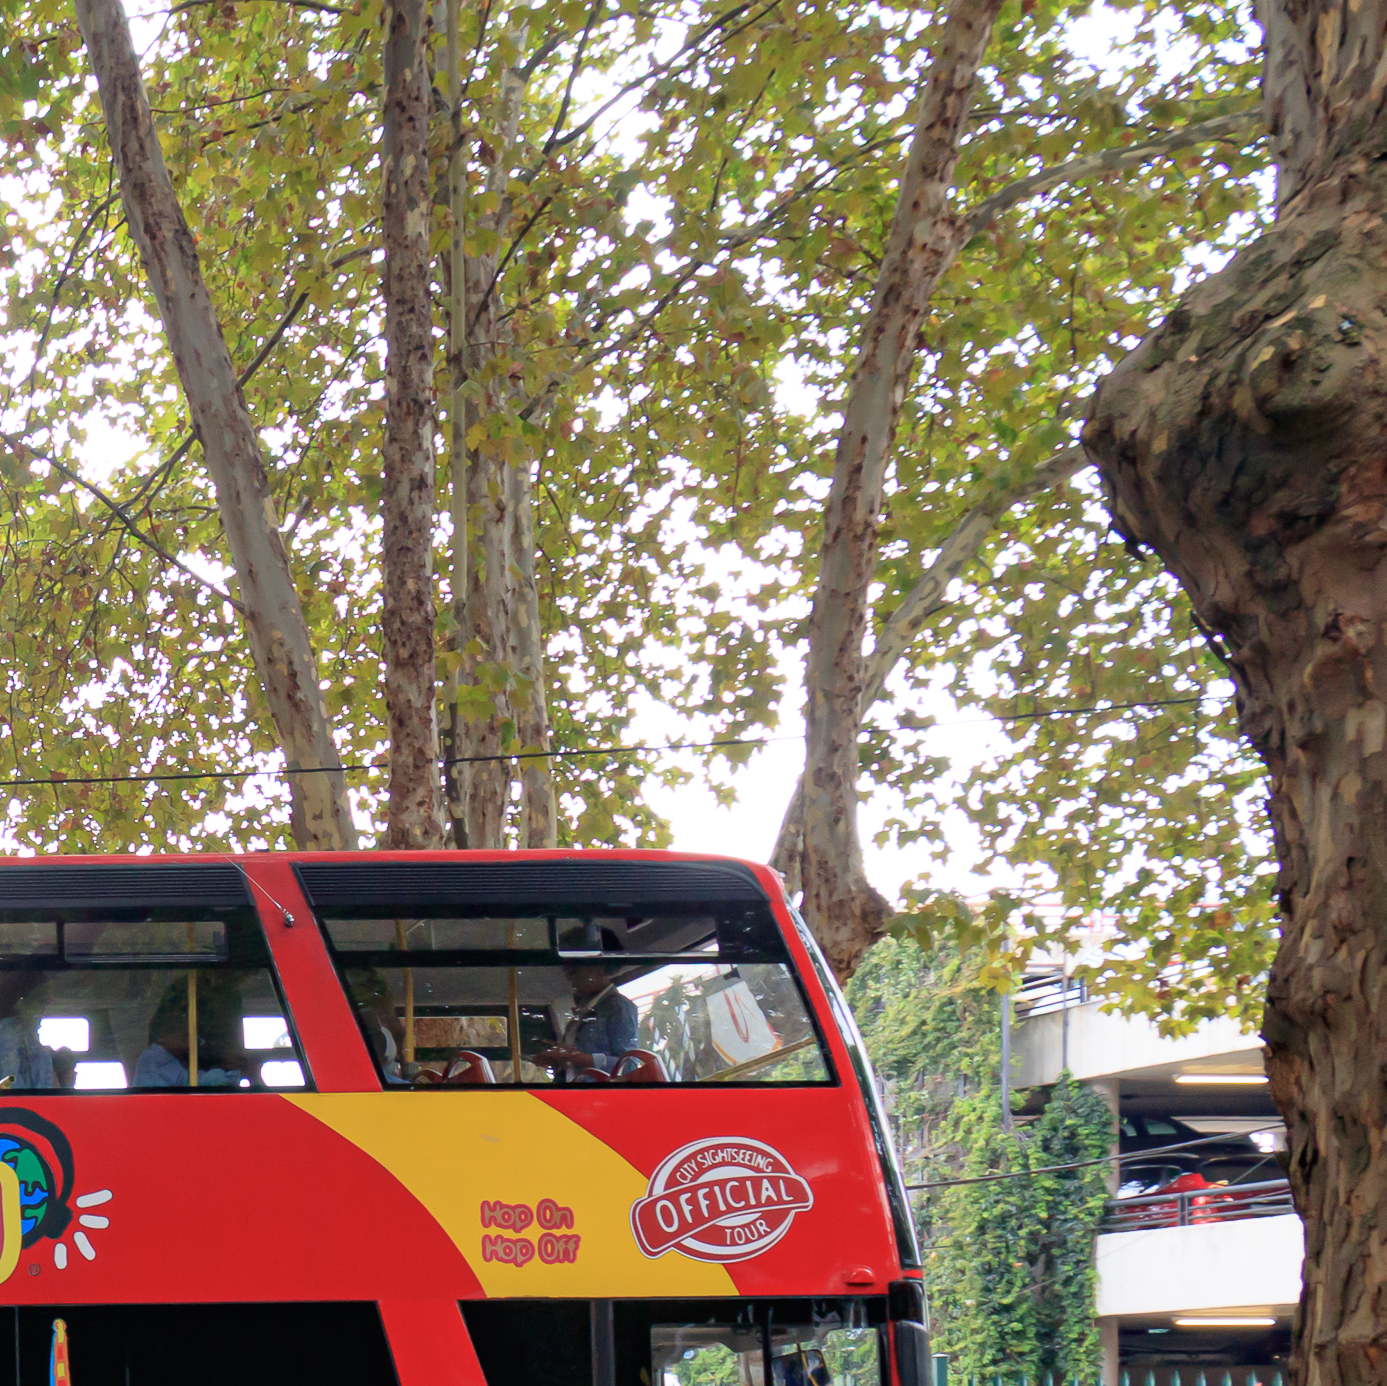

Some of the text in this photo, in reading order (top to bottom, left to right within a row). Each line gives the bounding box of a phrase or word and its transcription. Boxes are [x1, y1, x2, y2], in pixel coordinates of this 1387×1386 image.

[675, 1148, 774, 1184] CITY SIGHTSEEING
[480, 1198, 574, 1233] Hop On
[655, 1178, 794, 1233] OFFICIAL
[482, 1232, 581, 1267] Hop Off
[724, 1219, 771, 1246] TOUR
